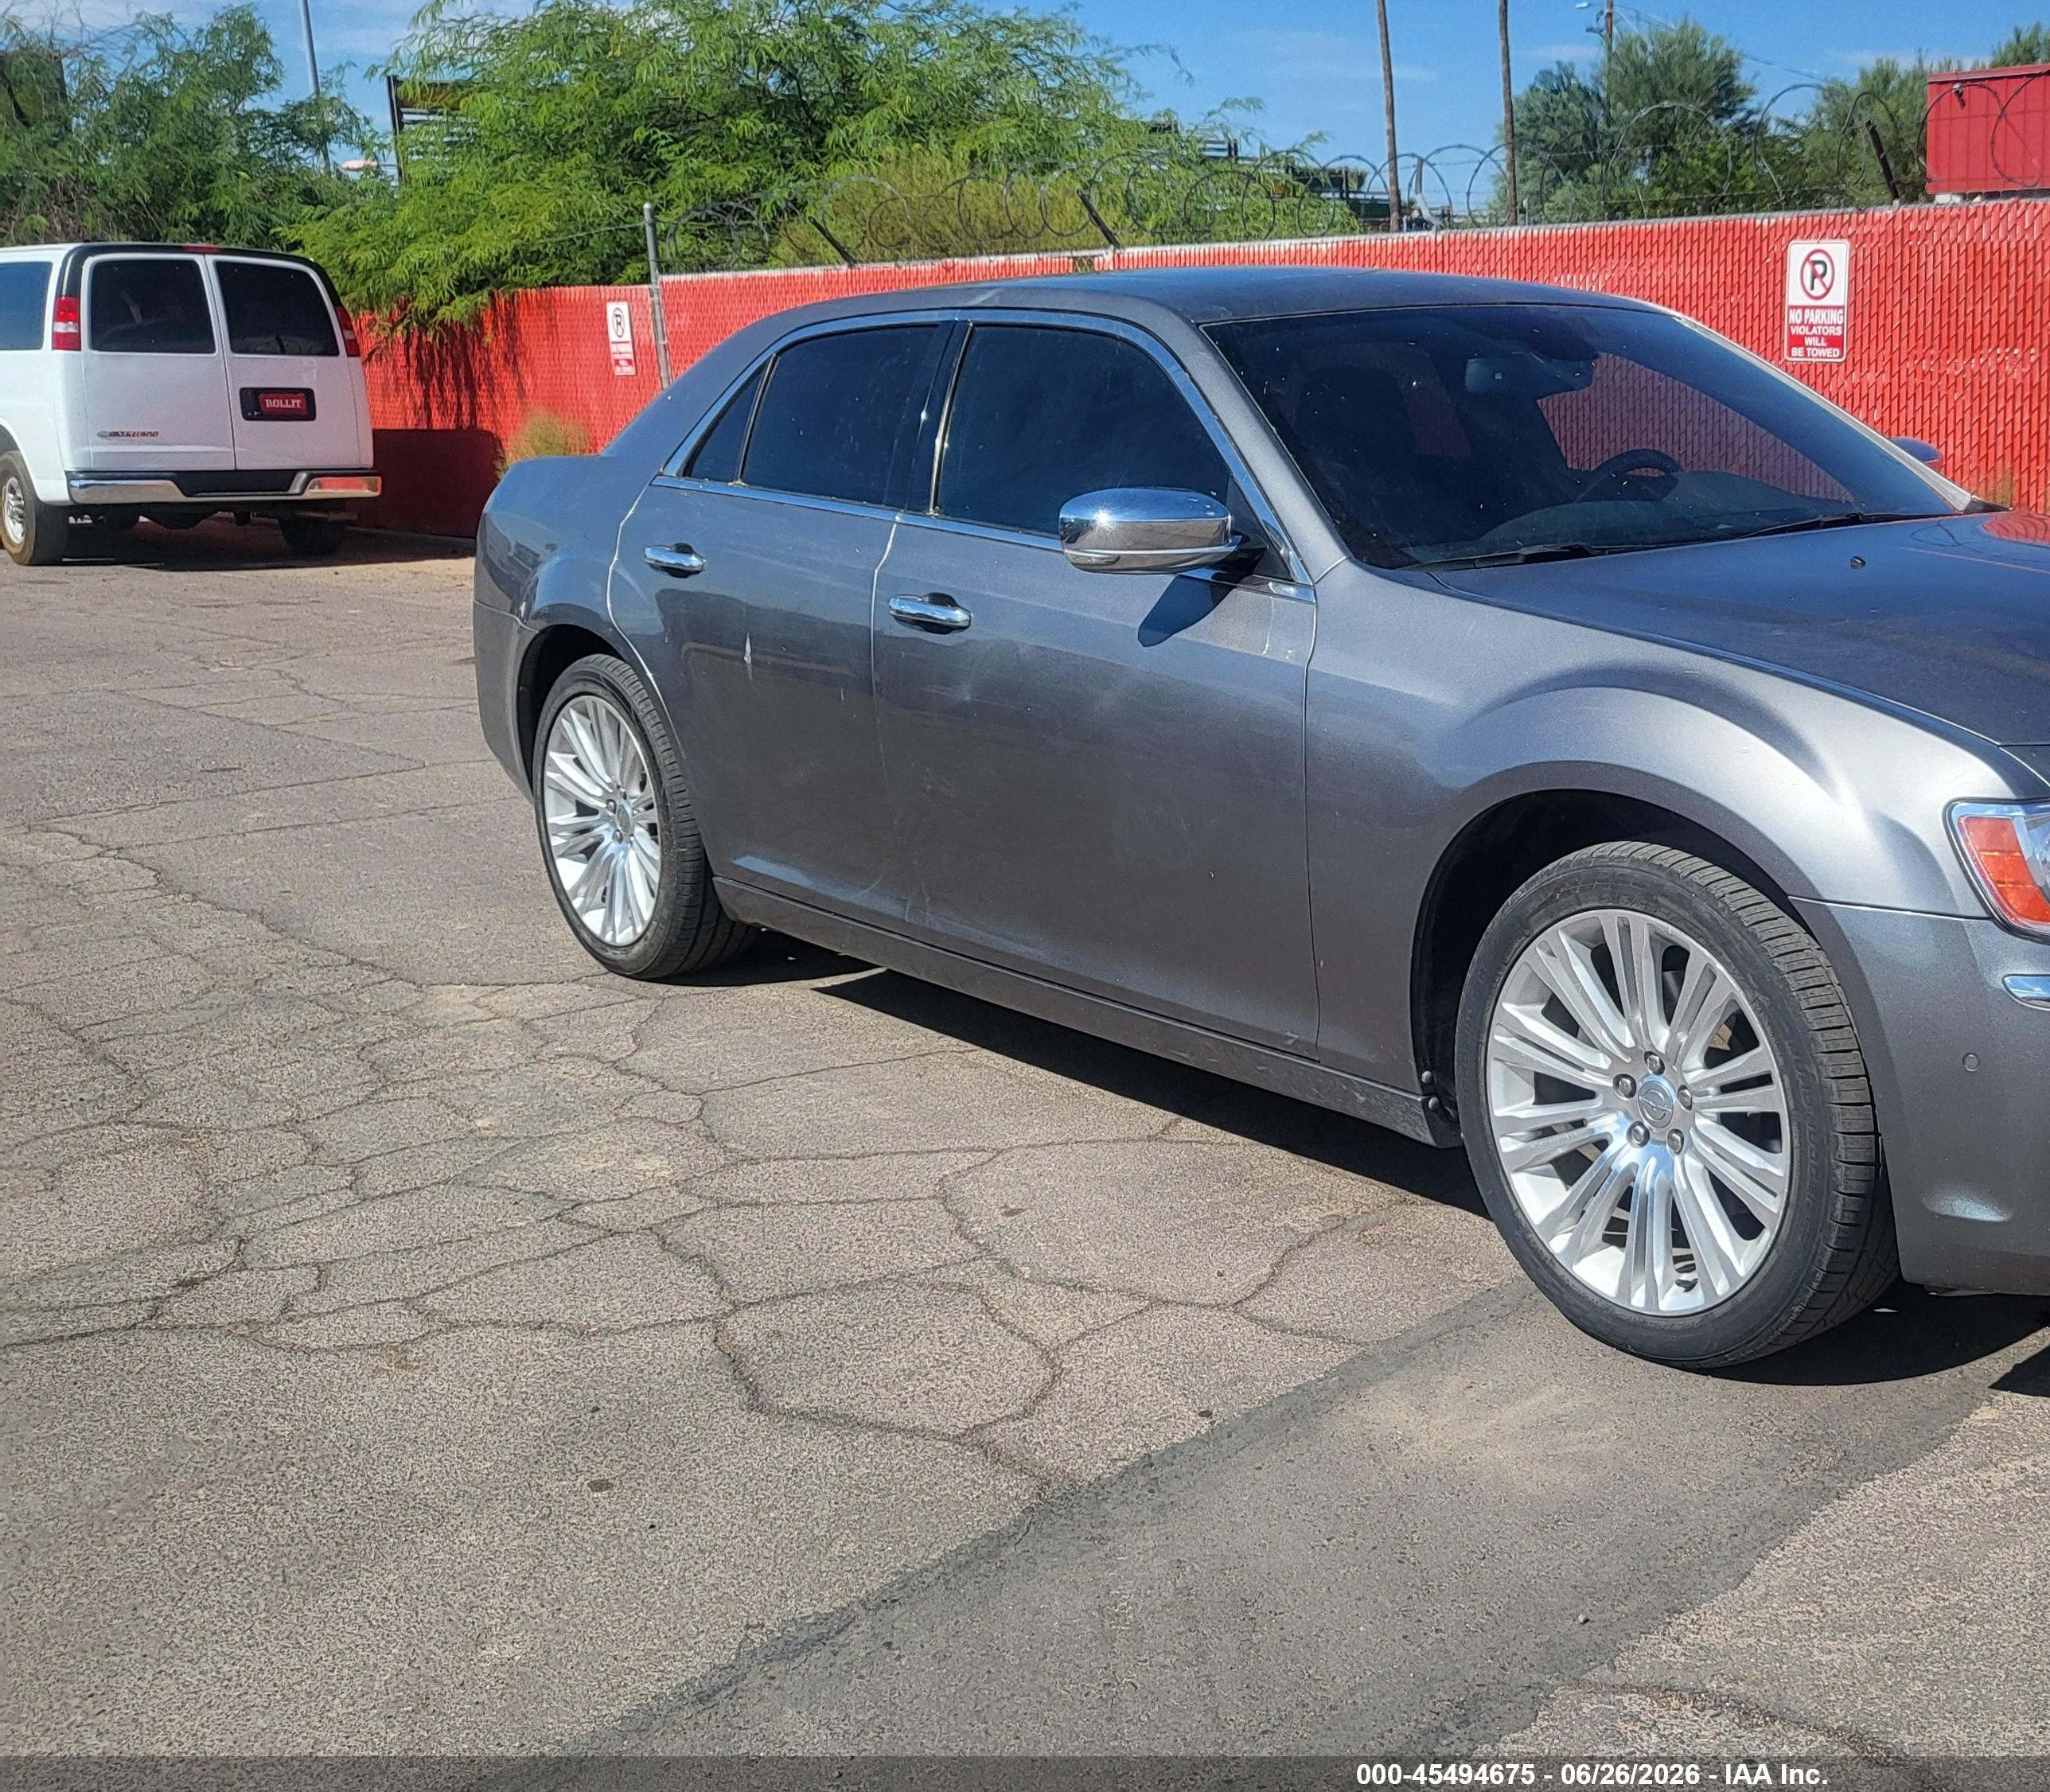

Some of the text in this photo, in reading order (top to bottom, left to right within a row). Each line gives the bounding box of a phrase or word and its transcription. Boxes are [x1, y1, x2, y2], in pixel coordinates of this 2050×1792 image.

[1788, 309, 1844, 325] NO PARKING
[1790, 325, 1842, 336] VIOLATORS
[1804, 337, 1828, 347] WILL
[1791, 347, 1841, 357] BE TOWED
[265, 399, 302, 408] ROLLIT
